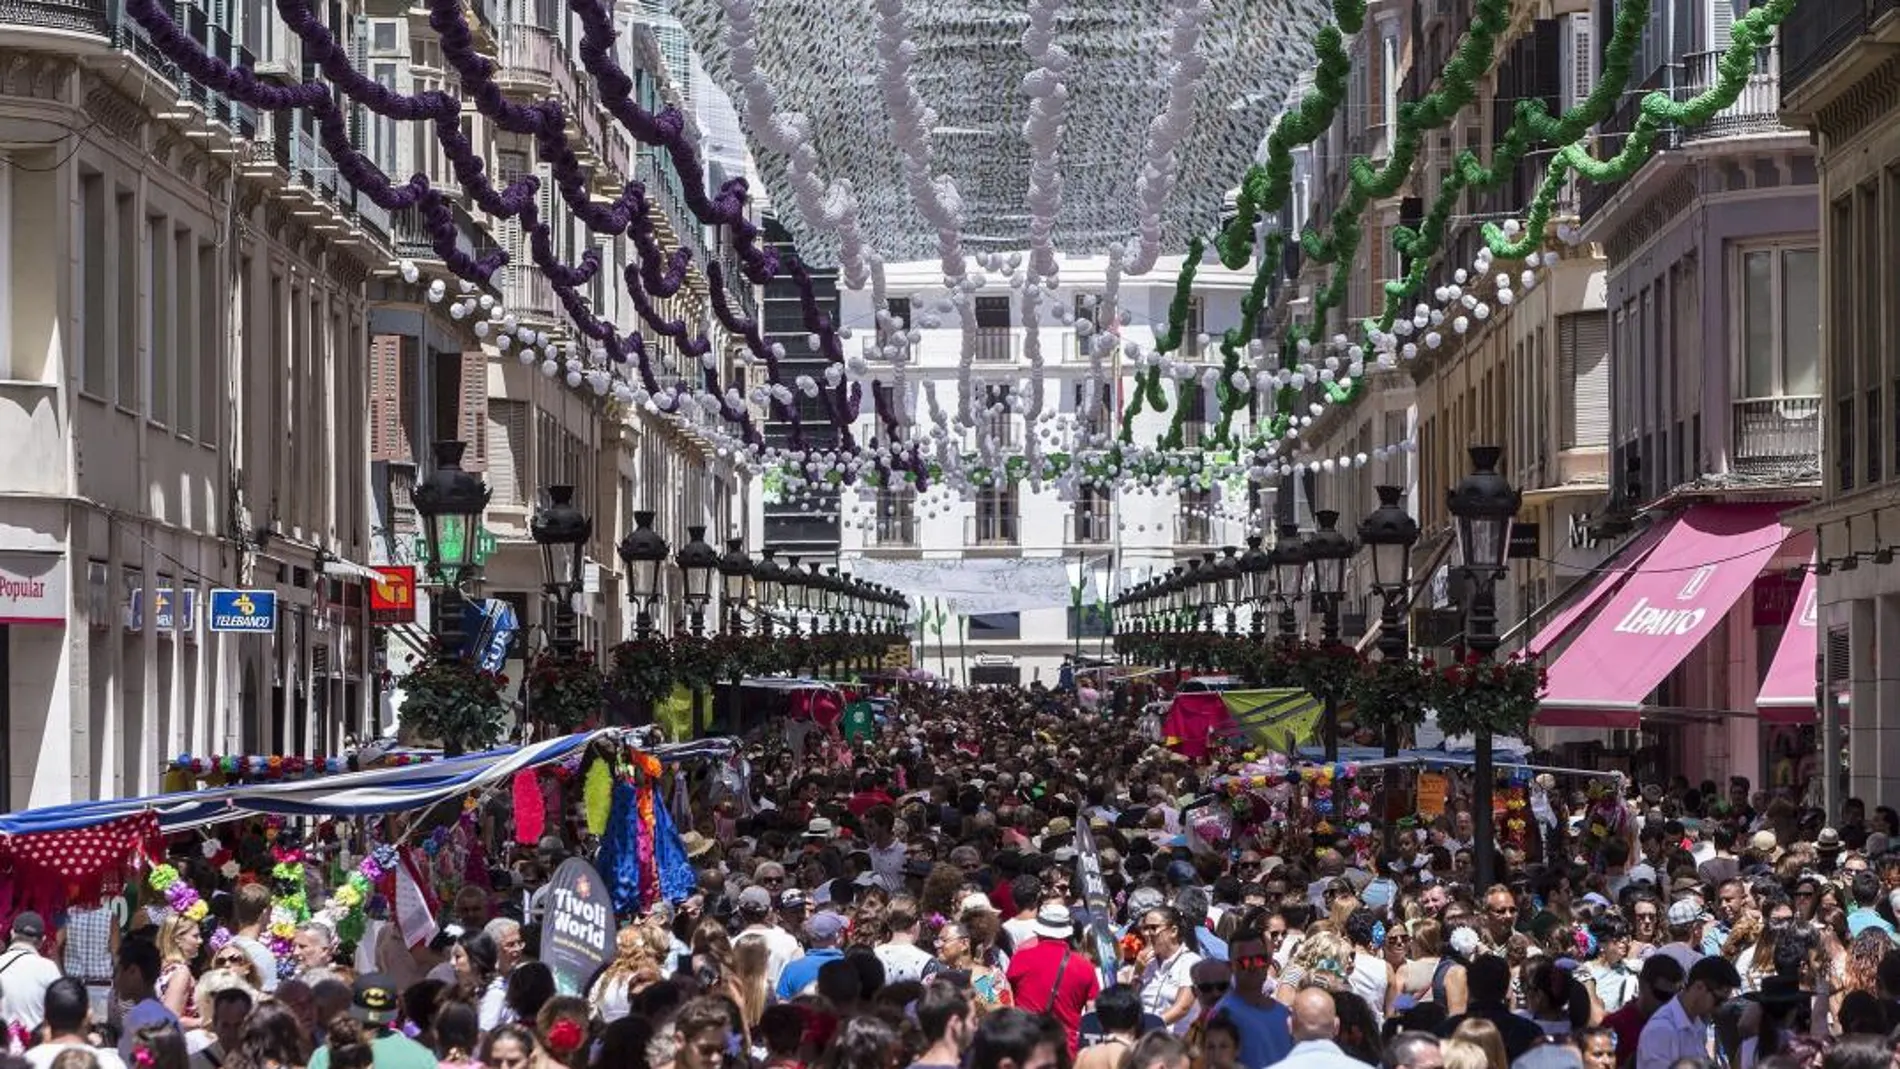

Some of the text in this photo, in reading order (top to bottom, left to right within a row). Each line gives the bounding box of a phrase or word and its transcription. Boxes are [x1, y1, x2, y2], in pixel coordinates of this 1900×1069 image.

[0, 575, 45, 603] Popular
[215, 615, 270, 628] TELEBANCO
[1614, 597, 1706, 636] LEPANTO
[554, 888, 606, 929] Tivoli
[554, 909, 605, 950] World
